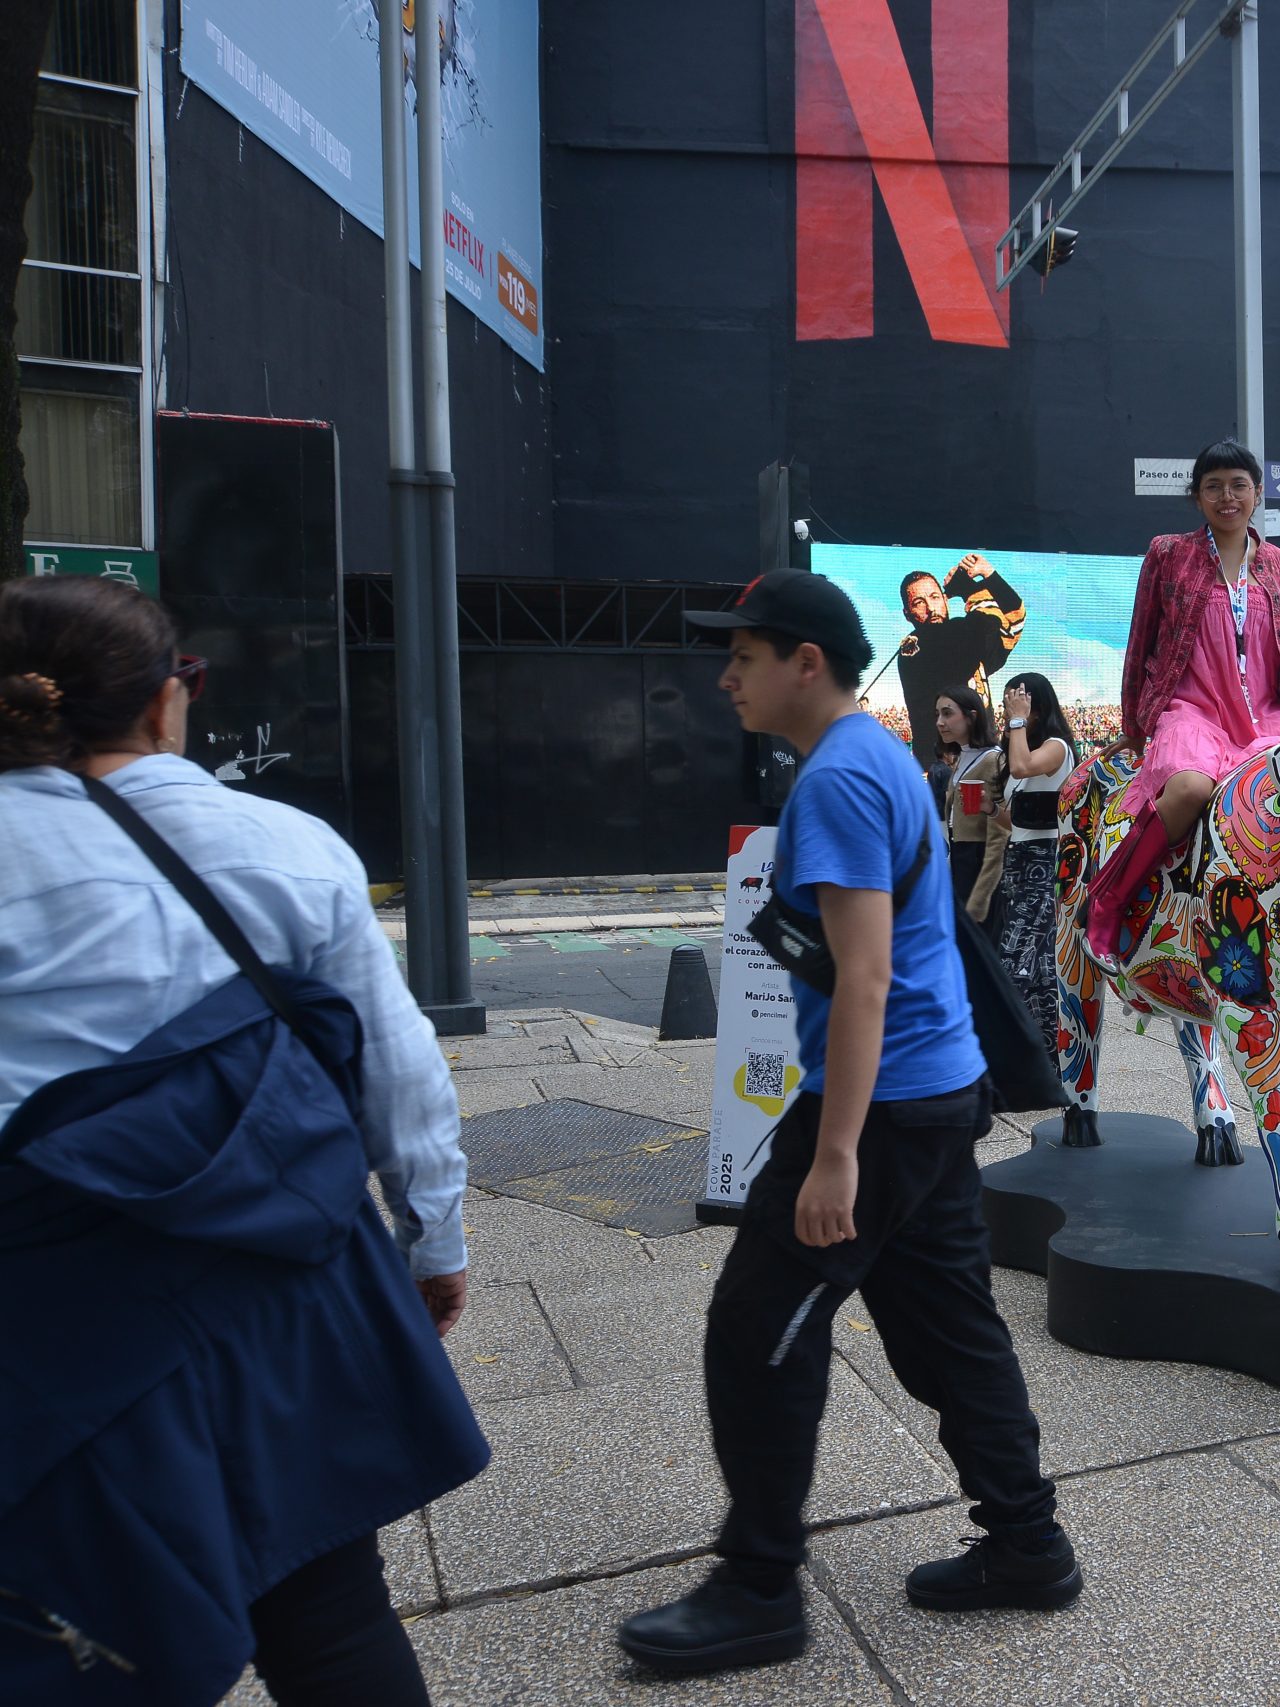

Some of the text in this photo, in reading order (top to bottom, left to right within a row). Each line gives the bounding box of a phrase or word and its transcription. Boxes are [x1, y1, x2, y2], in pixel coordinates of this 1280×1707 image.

[451, 191, 474, 222] SOLO EN
[443, 208, 484, 279] NETFLIX
[445, 258, 482, 300] 25 DE JULIO
[507, 271, 526, 316] 119
[1139, 470, 1169, 479] Paseo
[1172, 471, 1184, 479] de
[725, 946, 734, 954] el
[747, 962, 789, 971] con amo
[745, 991, 776, 1002] MariJo
[710, 1109, 723, 1193] COW PARADE
[720, 1153, 733, 1195] 2025
